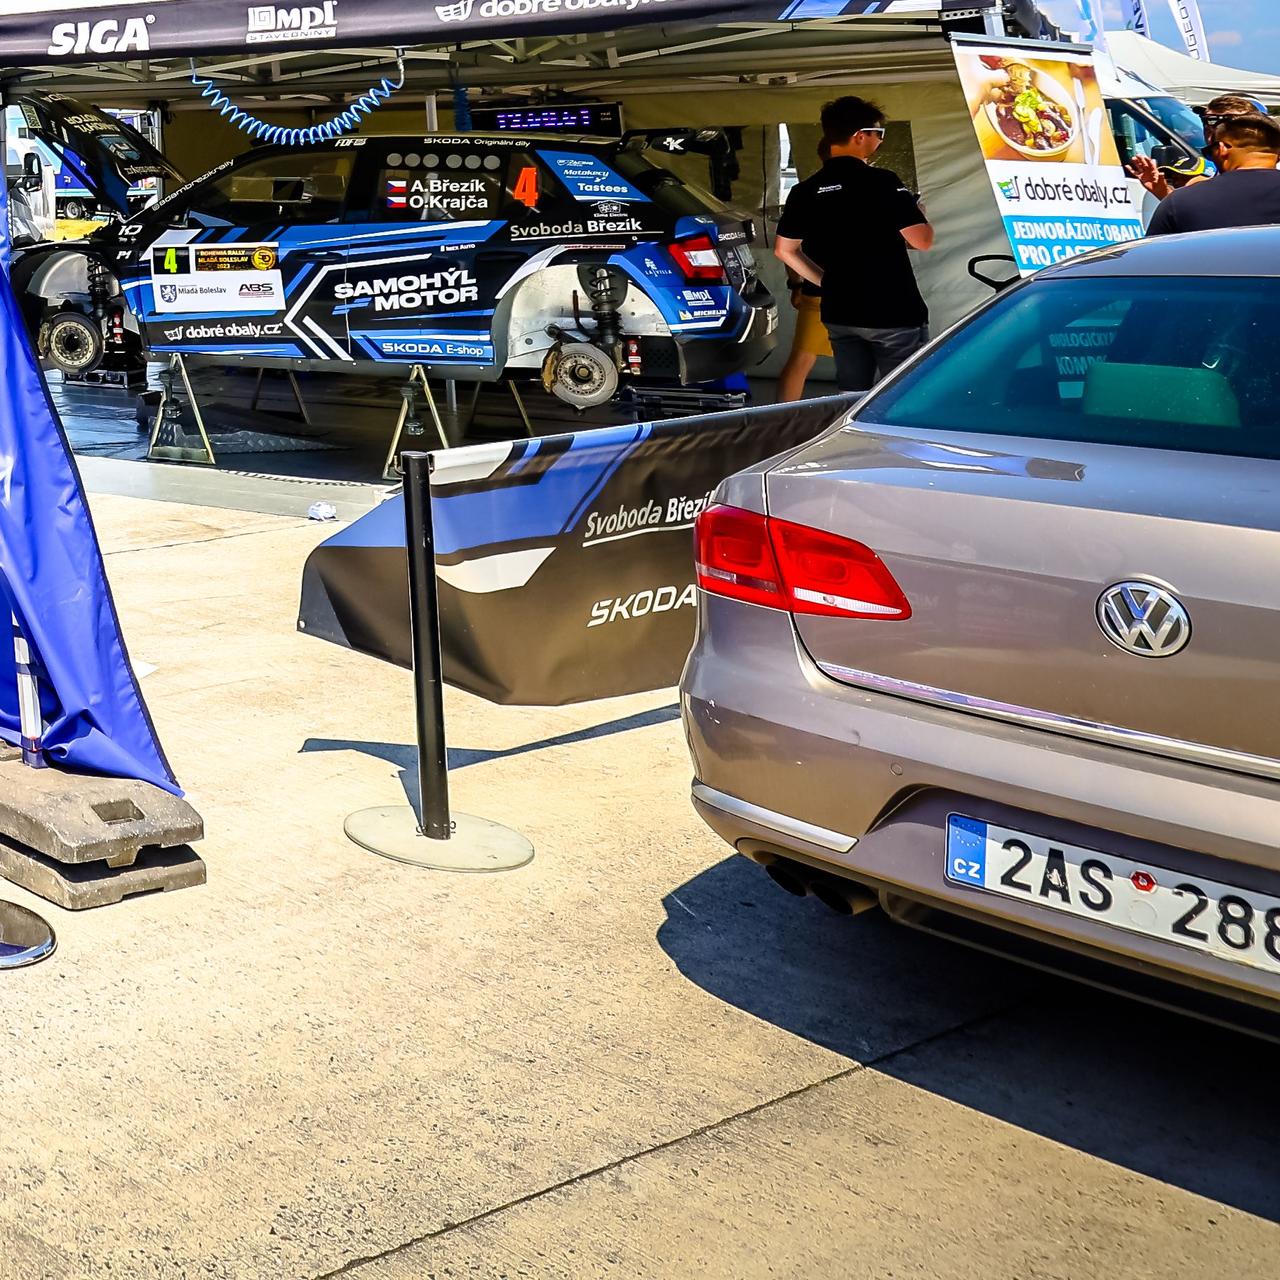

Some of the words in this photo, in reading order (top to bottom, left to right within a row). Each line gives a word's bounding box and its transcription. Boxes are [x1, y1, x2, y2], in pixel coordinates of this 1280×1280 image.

[47, 18, 151, 55] SIGA
[513, 167, 538, 207] 4
[577, 183, 628, 193] Tastees
[1024, 177, 1073, 202] dobré
[1075, 179, 1132, 208] obaly.cz
[510, 221, 583, 237] Svoboda
[587, 218, 643, 233] Březík
[1012, 219, 1104, 241] JEDNORÁZOVÉ
[1104, 223, 1142, 242] OBALY
[164, 248, 178, 274] 4
[1017, 245, 1051, 266] PRO
[199, 286, 227, 295] Boleslav
[239, 283, 274, 292] ABS
[334, 267, 477, 299] SAMOHÝL
[374, 286, 479, 312] MOTOR
[693, 309, 727, 317] MICHELIN
[186, 324, 224, 339] dobré
[225, 322, 283, 338] obaly.cz
[446, 344, 484, 357] E-shop
[584, 499, 662, 539] Svoboda
[665, 490, 716, 524] Březí
[953, 858, 981, 879] CZ
[1000, 838, 1114, 912] 2AS
